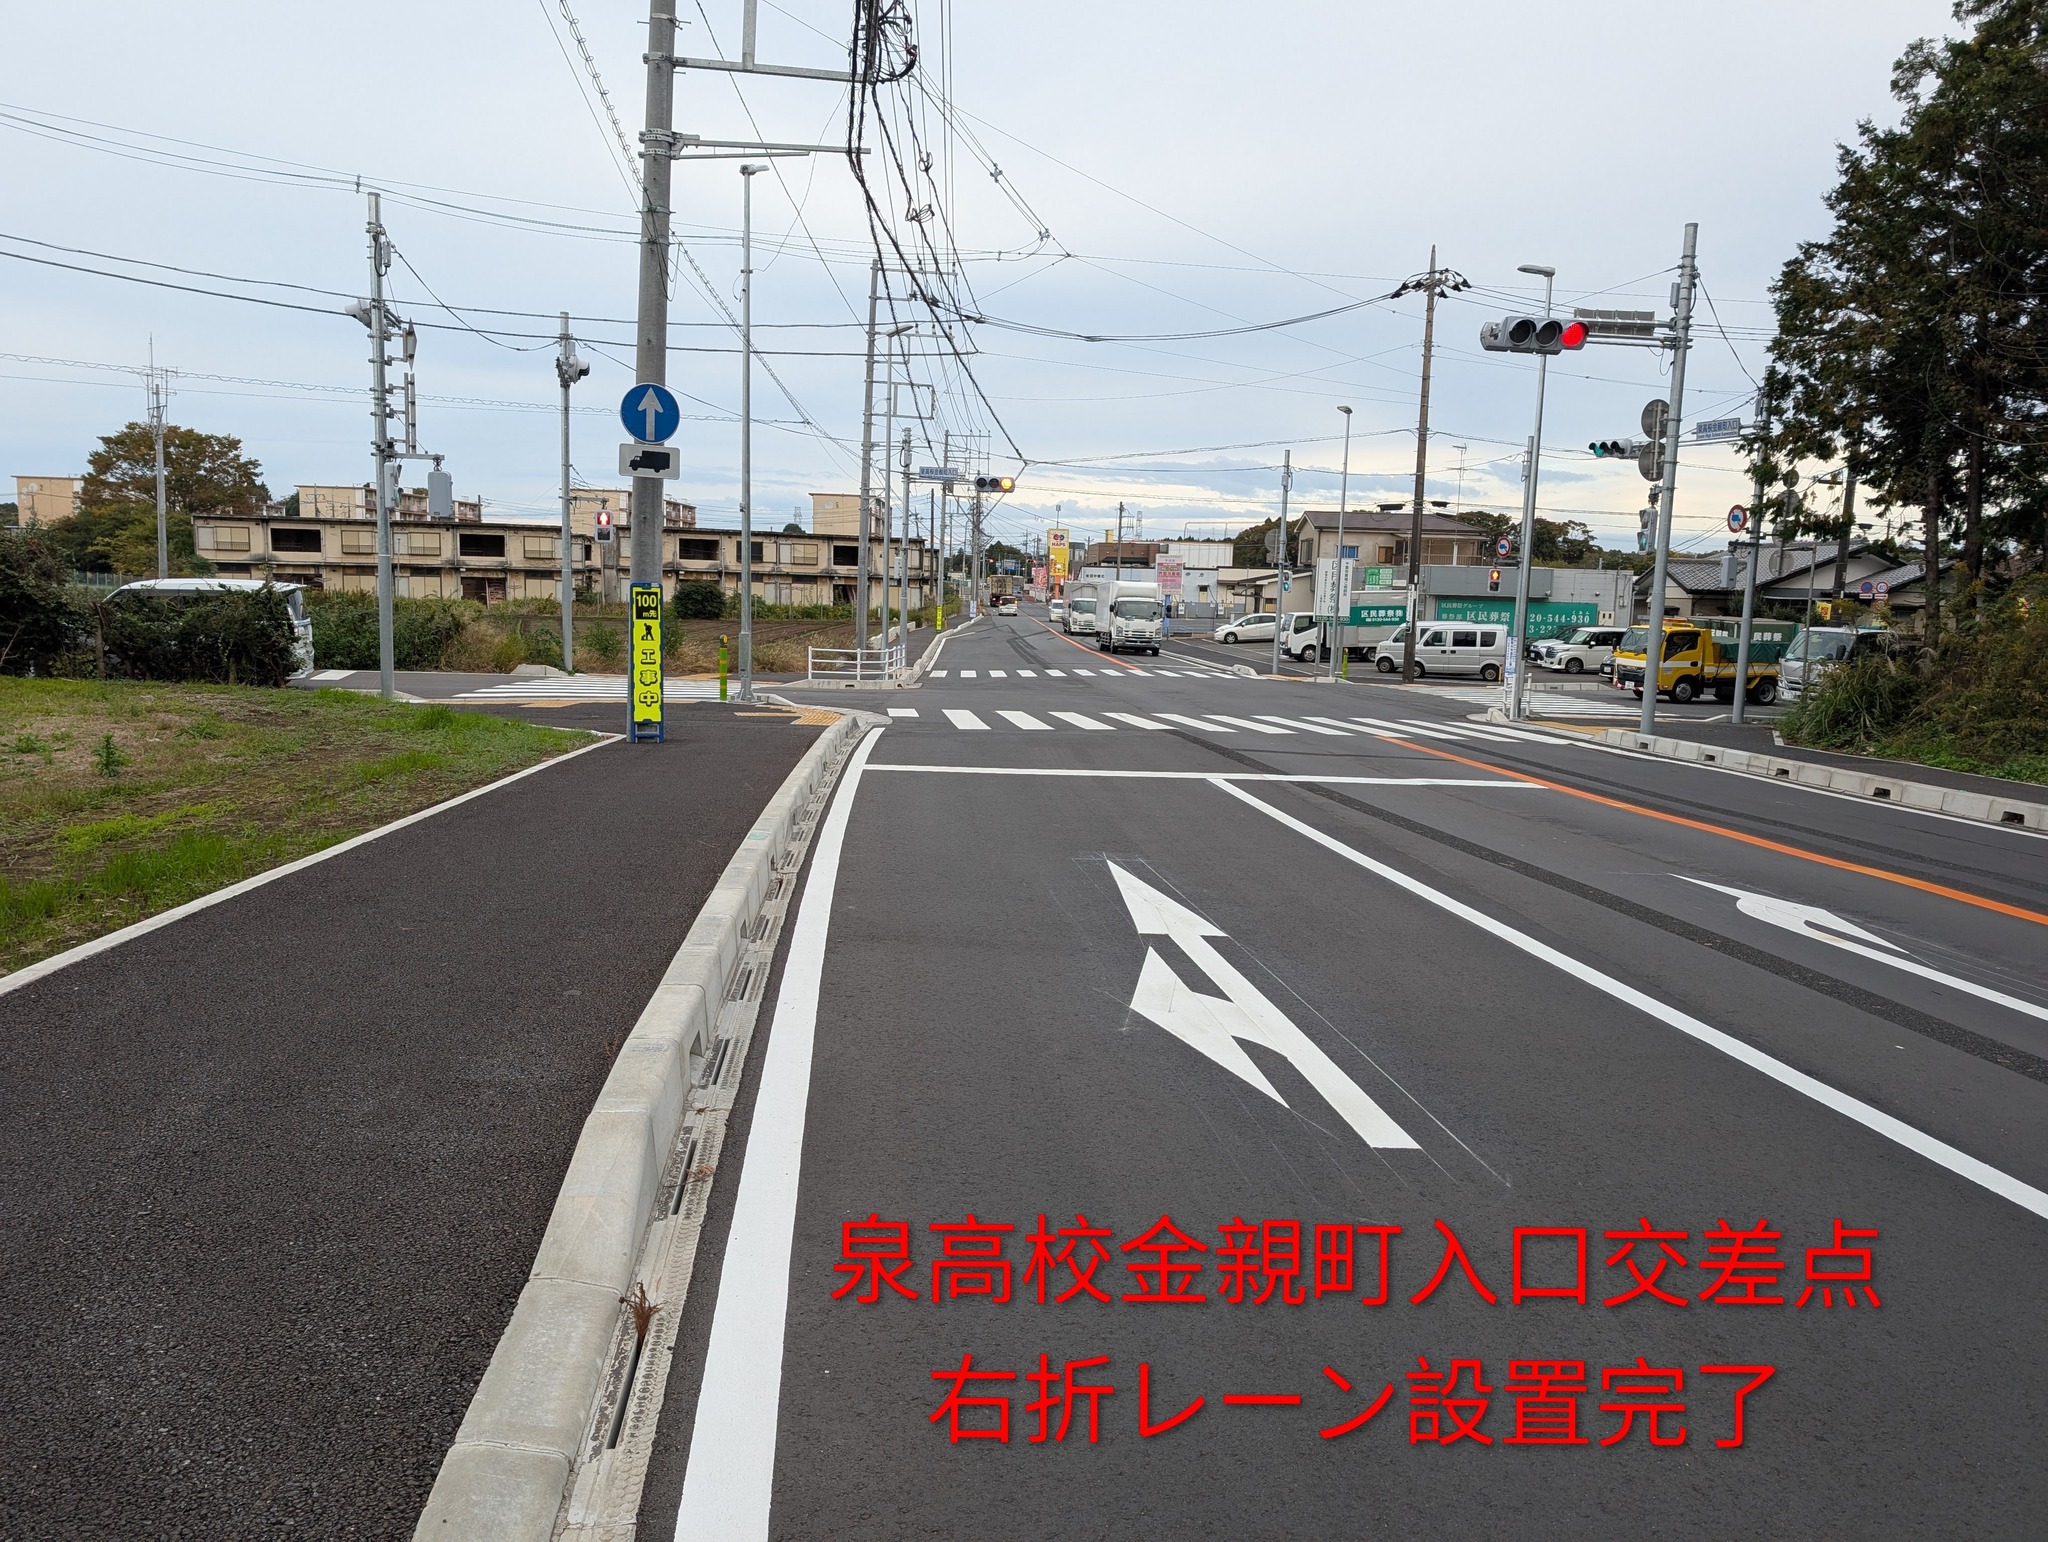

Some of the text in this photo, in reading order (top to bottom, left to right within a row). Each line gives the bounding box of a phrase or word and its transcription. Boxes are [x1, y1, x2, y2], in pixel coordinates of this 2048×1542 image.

[636, 595, 657, 608] 100
[642, 610, 657, 618] m先
[1466, 611, 1511, 622] 区民葬祭
[1529, 613, 1590, 624] 20-544-930
[1753, 632, 1782, 641] 民葬祭
[639, 649, 659, 707] 工事中
